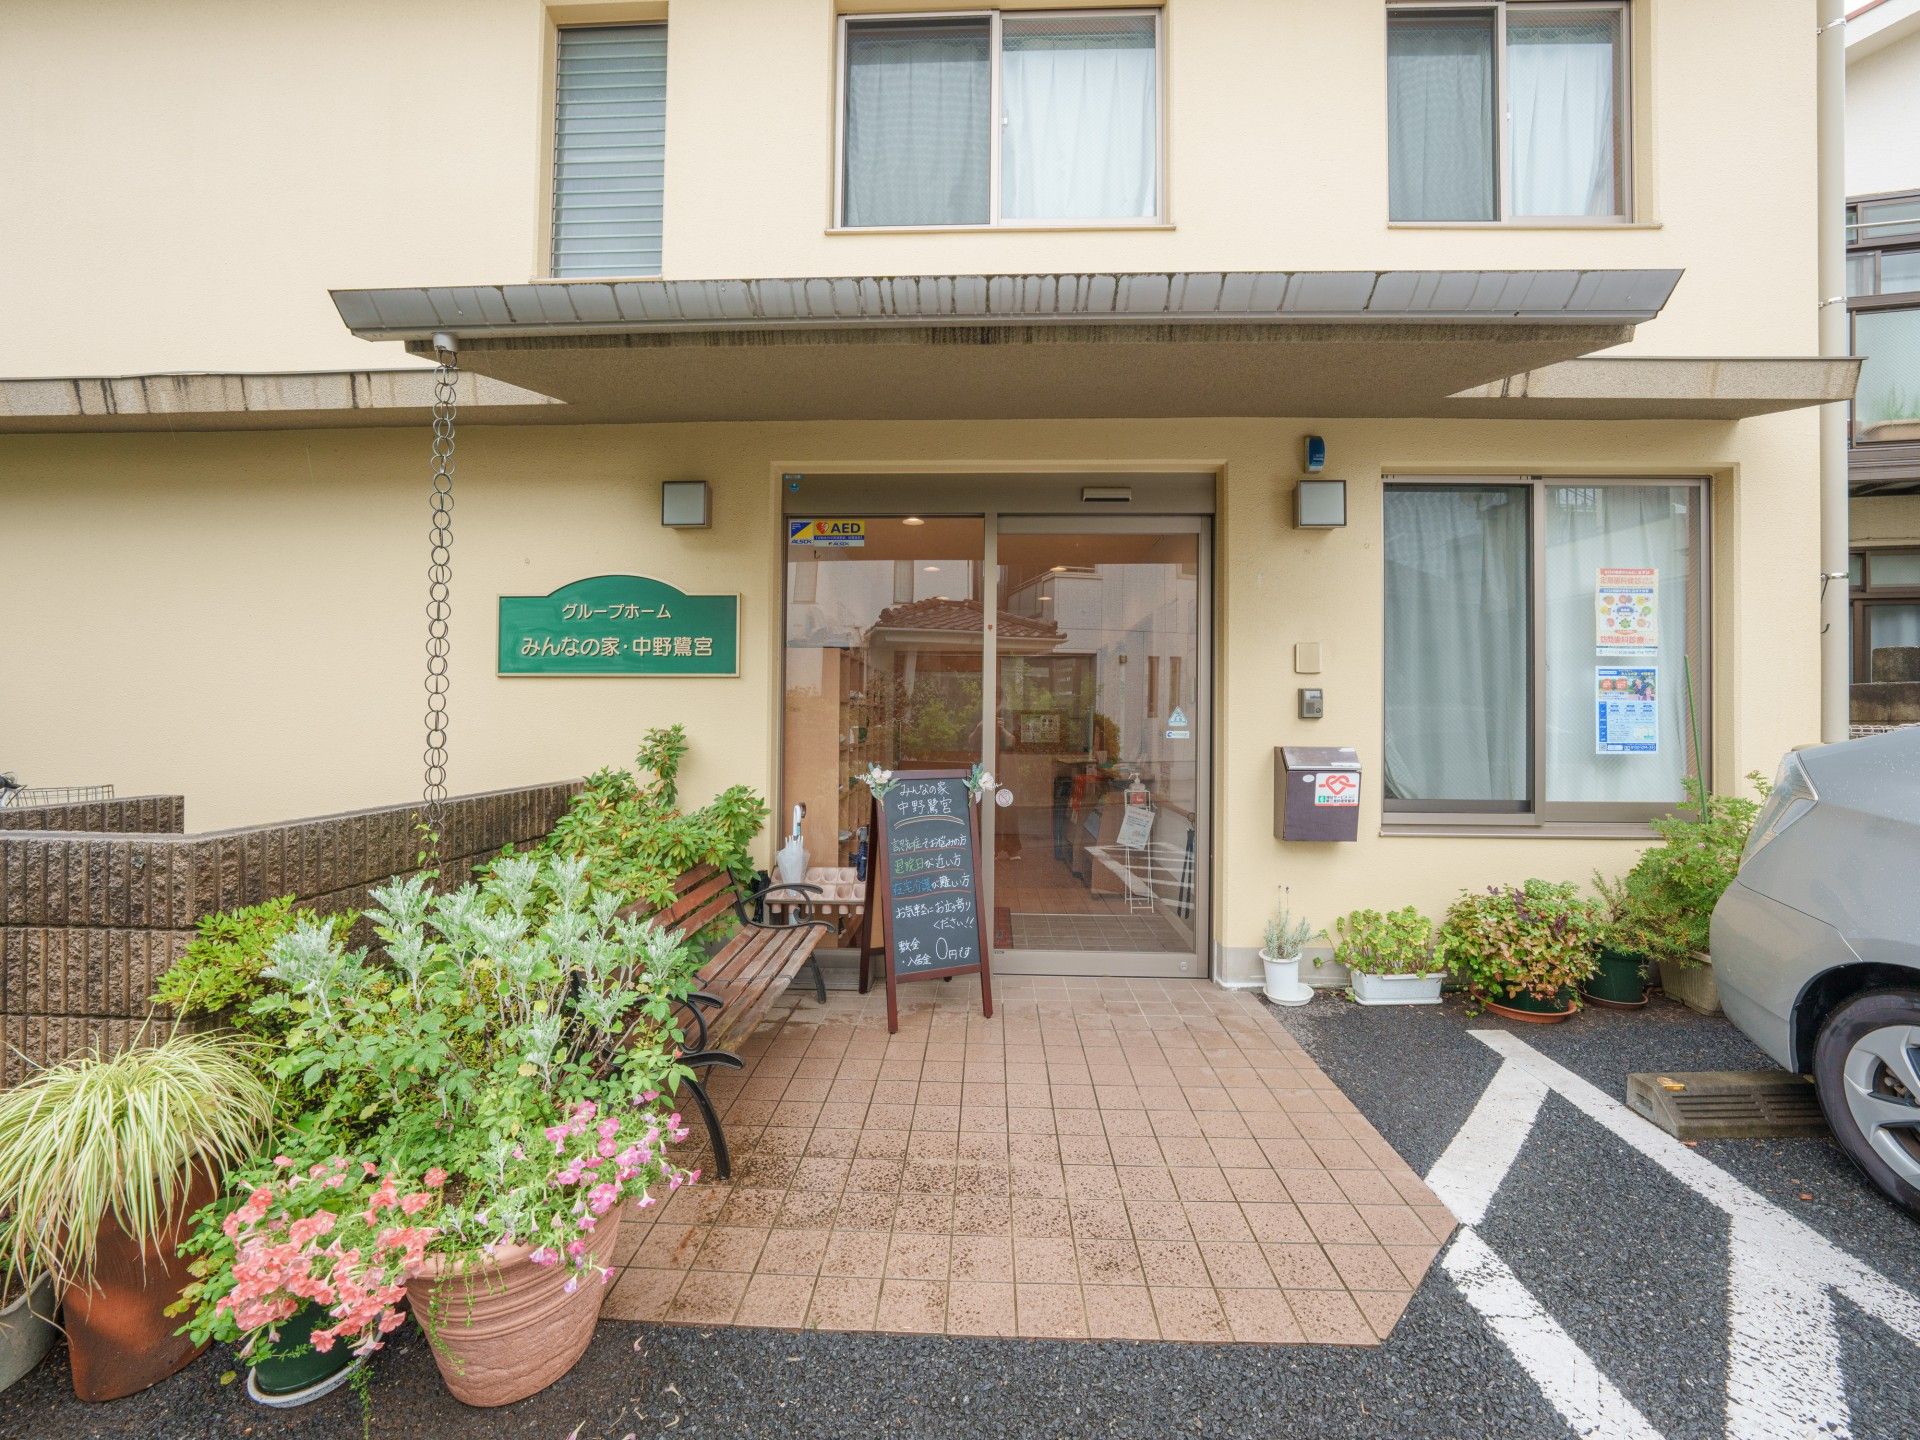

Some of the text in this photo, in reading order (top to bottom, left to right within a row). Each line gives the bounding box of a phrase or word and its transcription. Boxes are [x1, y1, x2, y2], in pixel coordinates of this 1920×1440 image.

[831, 523, 861, 534] AED
[562, 603, 672, 620] グループホーム
[899, 781, 950, 797] みんなの家
[897, 797, 953, 816] 中野鷺宮
[895, 852, 961, 874] 退院日が近い方
[898, 937, 921, 954] 敷金
